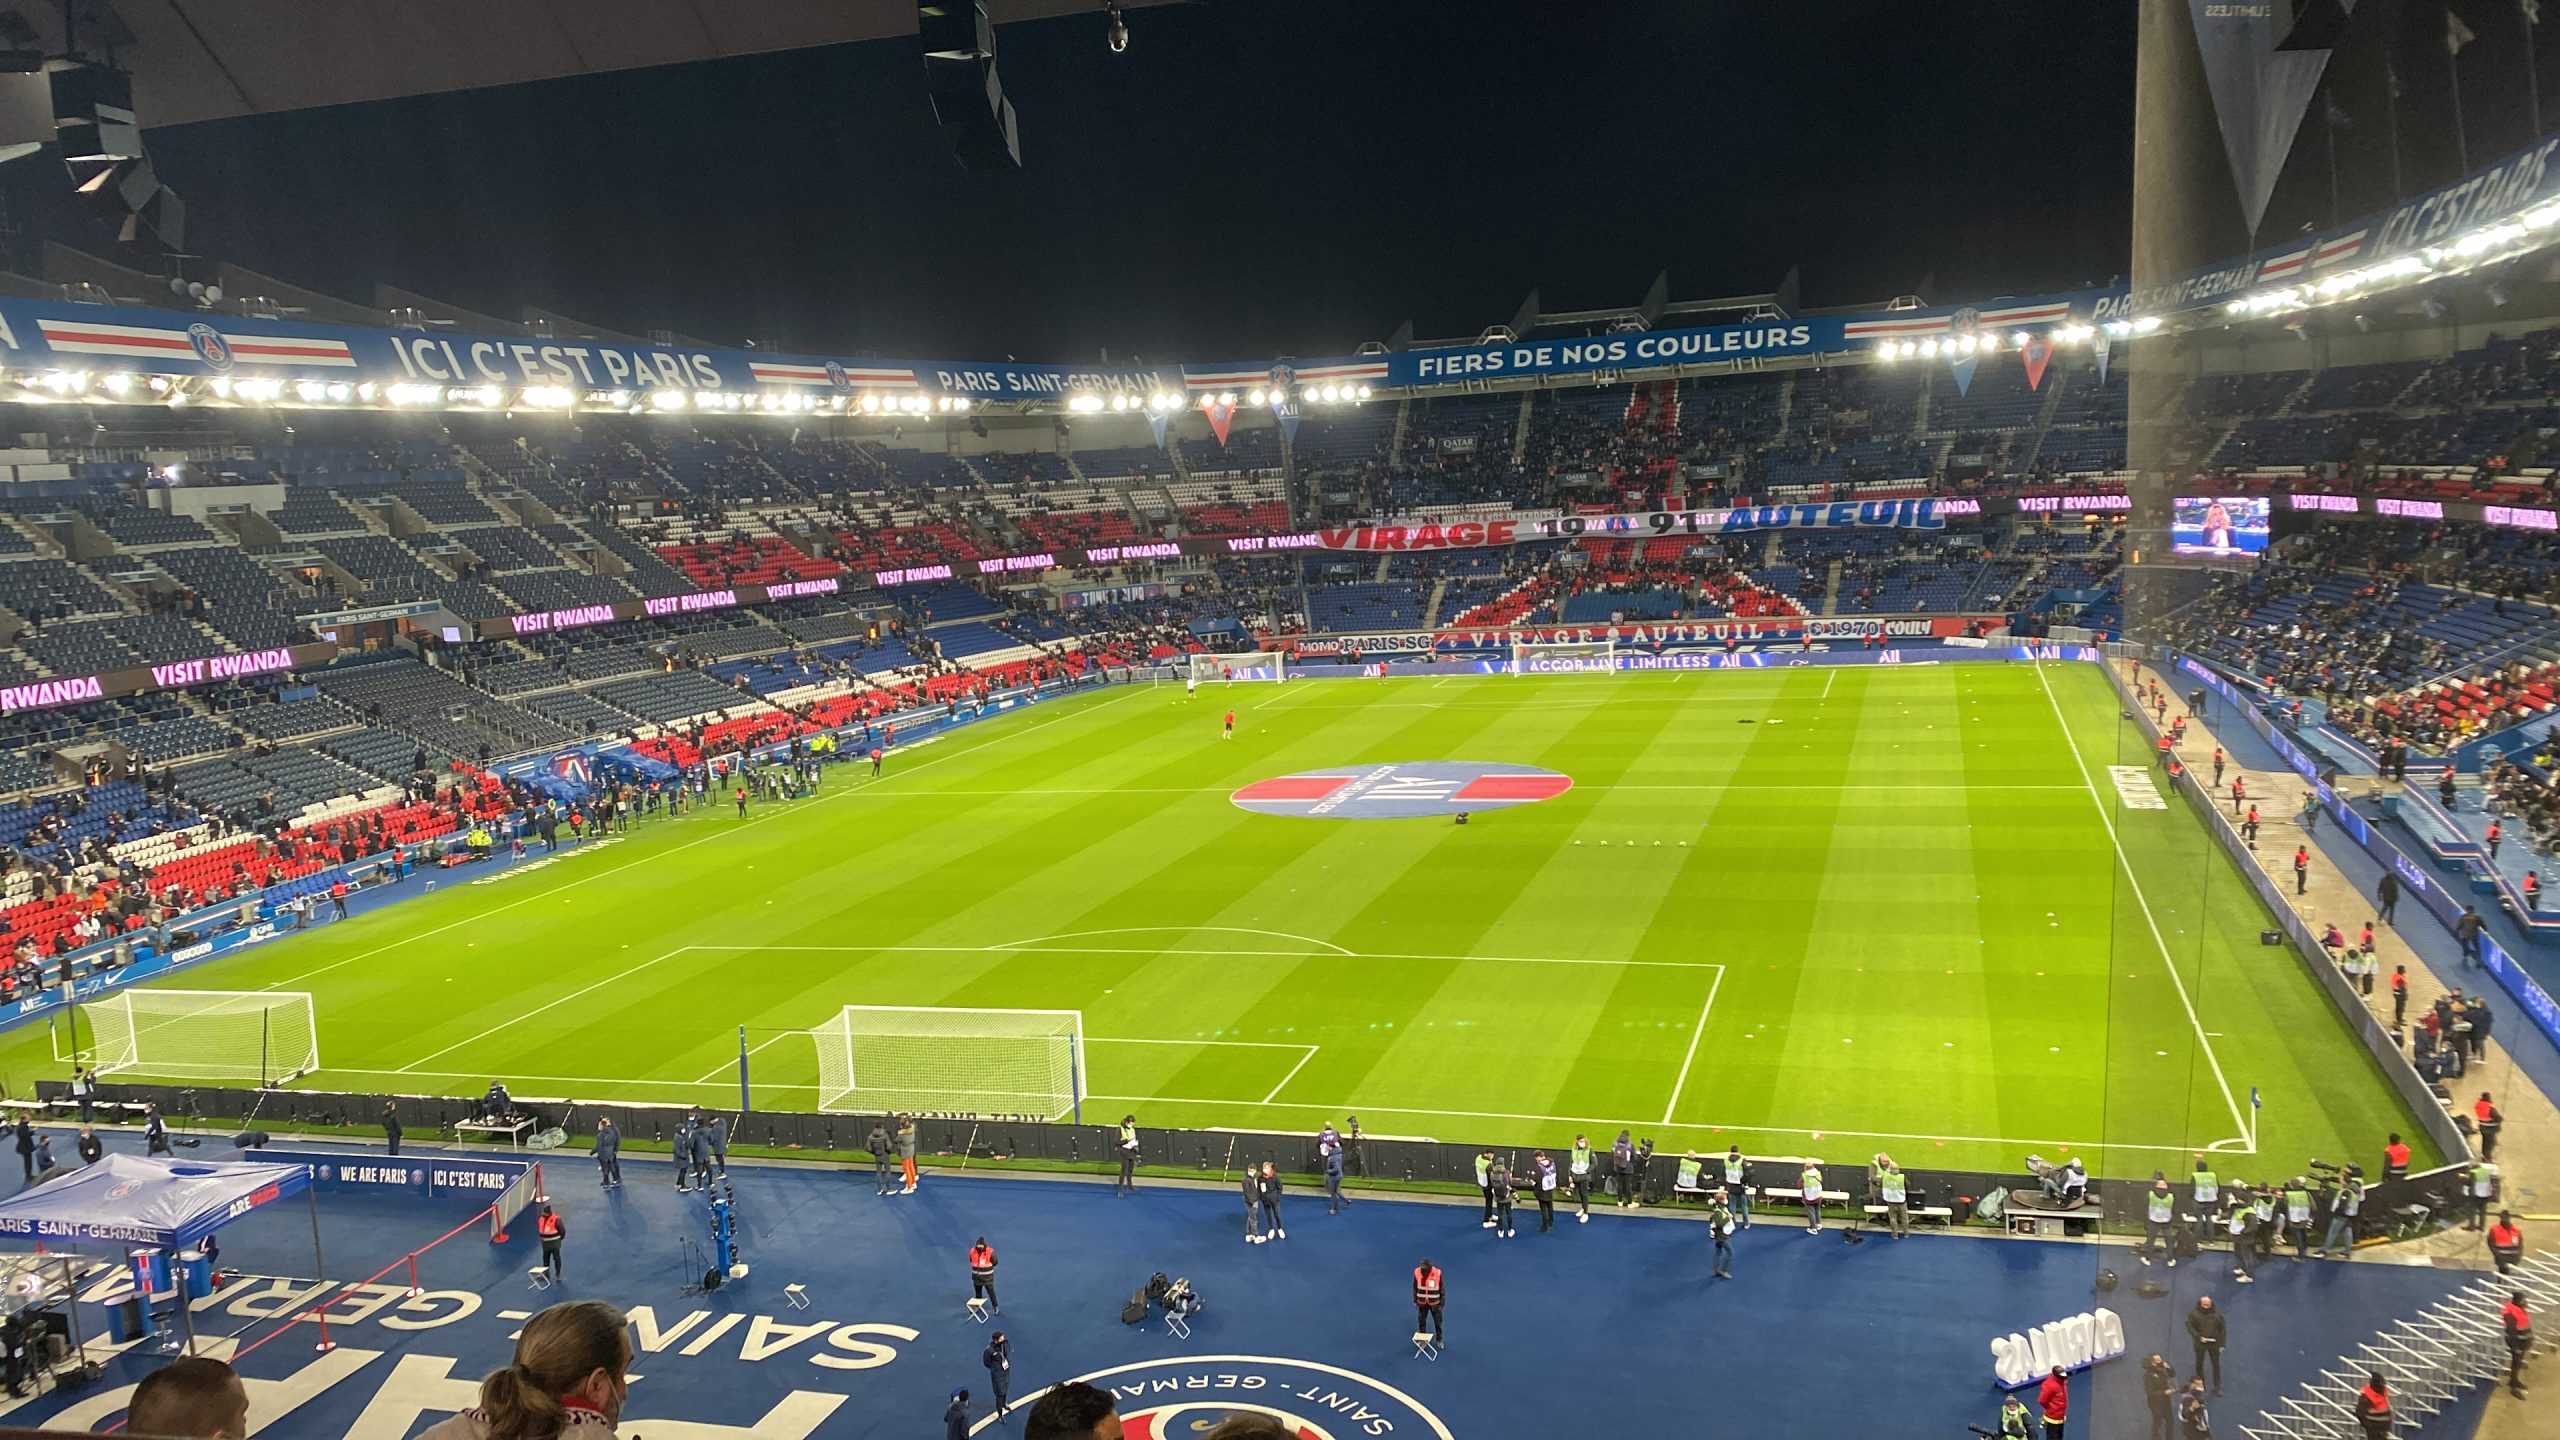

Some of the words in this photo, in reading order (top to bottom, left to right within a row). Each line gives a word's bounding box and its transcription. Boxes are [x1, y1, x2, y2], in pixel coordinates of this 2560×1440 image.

[1418, 350, 1503, 377] FIERS
[1513, 347, 1553, 368] DE
[1562, 341, 1627, 365] NOS
[1636, 325, 1811, 358] COULEURS
[390, 336, 466, 381] ICI
[470, 341, 596, 385] C'EST
[599, 348, 723, 389] PARIS
[937, 370, 1001, 391] PARIS
[1006, 371, 1162, 394] SAINT-GERMAIN
[1443, 438, 1474, 448] QATAR
[1696, 466, 1718, 474] QATAR
[2019, 497, 2060, 511] VISIT
[2064, 494, 2132, 510] RWANDA
[1318, 519, 1521, 551] VIRAGE
[1540, 517, 1586, 538] 19
[1649, 512, 1699, 535] 91
[1720, 497, 1946, 534] AUTEUIL
[1086, 547, 1119, 563] VISIT
[1122, 542, 1181, 560] RWANDA
[1227, 537, 1264, 552] VISIT
[1267, 534, 1319, 550] RWAND
[978, 557, 1004, 573] VISIT
[1006, 553, 1055, 570] RWANDA
[875, 569, 903, 586] VISIT
[906, 564, 952, 583] RWANDA
[766, 583, 793, 599] VISIT
[795, 578, 839, 596] RWANDA
[644, 593, 678, 615] VISIT
[681, 589, 737, 610] RWANDA
[336, 614, 357, 624] PARIS
[358, 608, 409, 621] SAINT-GERMAIN
[511, 612, 549, 633] VISIT
[553, 604, 615, 628] RWANDA
[1470, 628, 1593, 648] VIRAGE
[1631, 623, 1764, 644] AUTEUIL
[1829, 621, 1881, 637] 1970
[1885, 619, 1933, 636] COULY
[1299, 641, 1339, 653] MOMO
[1342, 635, 1399, 651] PARIS
[152, 661, 204, 686] VISIT
[209, 648, 293, 678] RWANDA
[1530, 659, 1584, 672] ACCOR
[1630, 655, 1711, 669] LIMITLESS
[0, 676, 103, 711] RWANDA
[340, 1165, 358, 1182] WE
[359, 1166, 377, 1183] ARE
[379, 1167, 407, 1185] PARIS
[434, 1169, 447, 1186] ICI
[449, 1171, 476, 1188] C'EST
[478, 1173, 505, 1190] PARIS
[229, 1195, 252, 1218] ARE
[0, 1219, 32, 1233] ARIS
[624, 1304, 921, 1370] SAIN
[1109, 1373, 1268, 1400] GERMAI
[1296, 1385, 1395, 1436] SAINT
